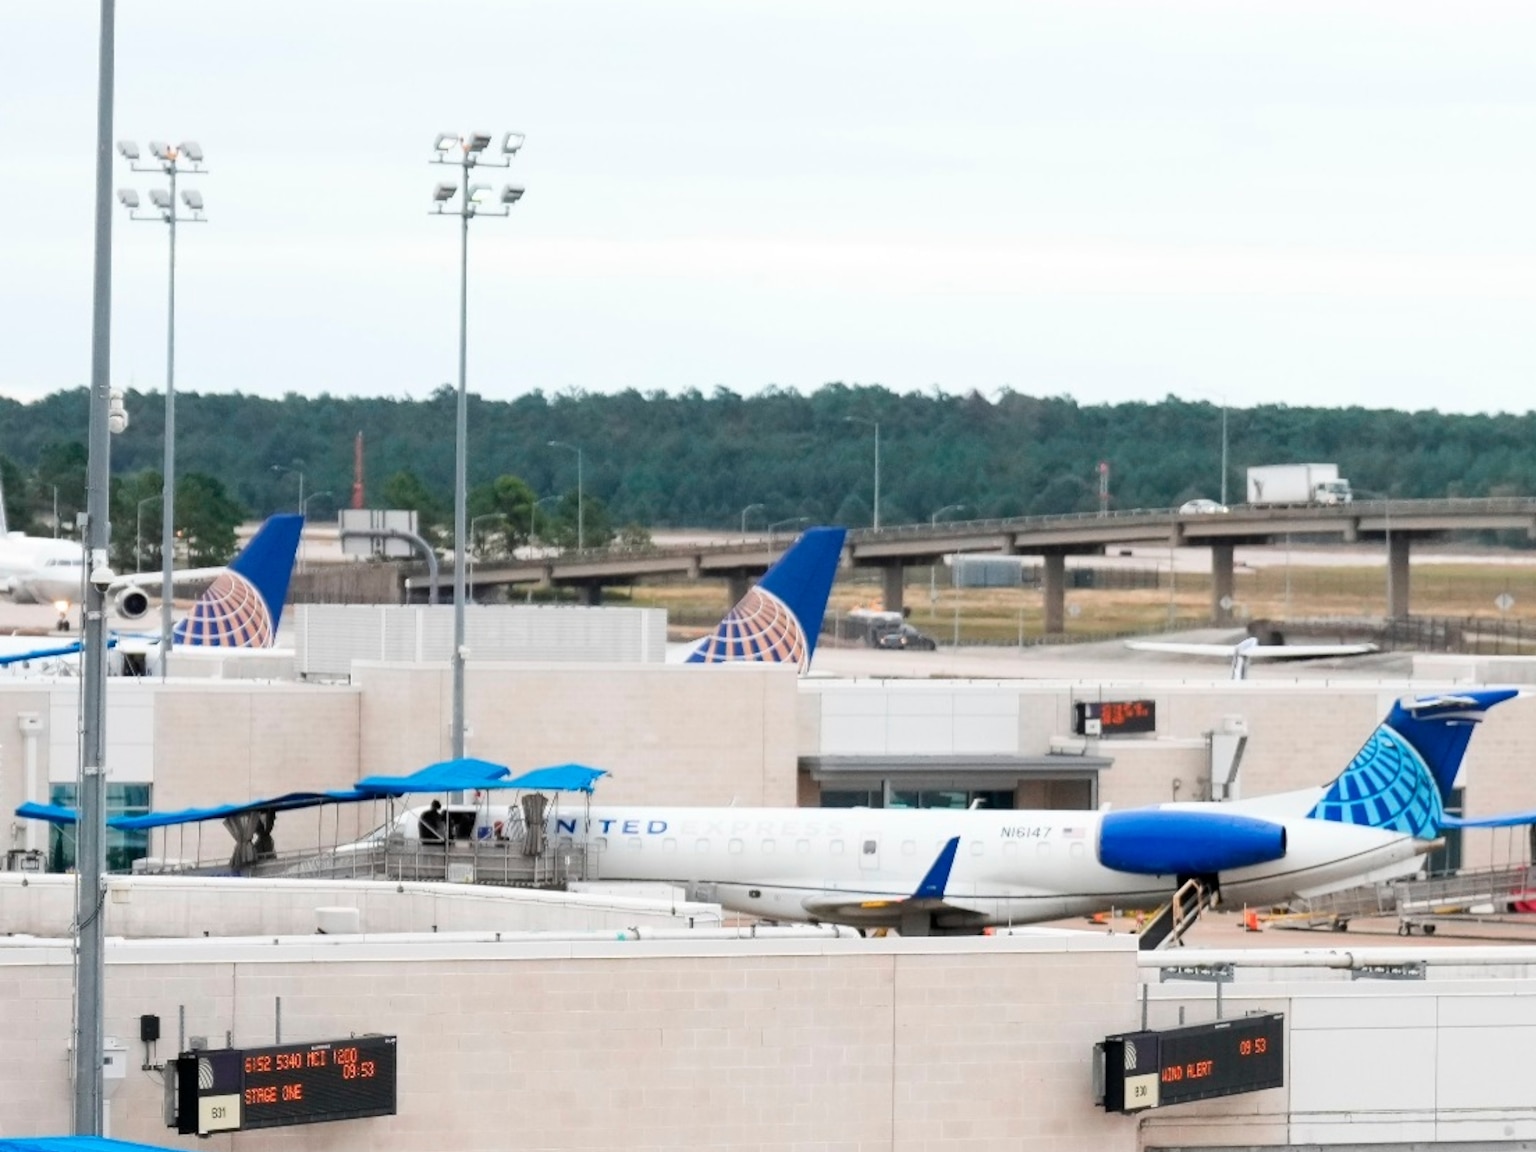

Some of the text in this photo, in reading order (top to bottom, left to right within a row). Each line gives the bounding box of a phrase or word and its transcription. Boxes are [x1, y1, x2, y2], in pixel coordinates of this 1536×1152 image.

[556, 819, 845, 836] NTED EXPRESS
[1001, 827, 1052, 838] N16147
[276, 1054, 302, 1071] 5340
[342, 1061, 376, 1080] 09:53
[1161, 1060, 1213, 1083] WIND ALERT
[244, 1083, 303, 1105] STAGE ONE
[211, 1107, 227, 1119] B31
